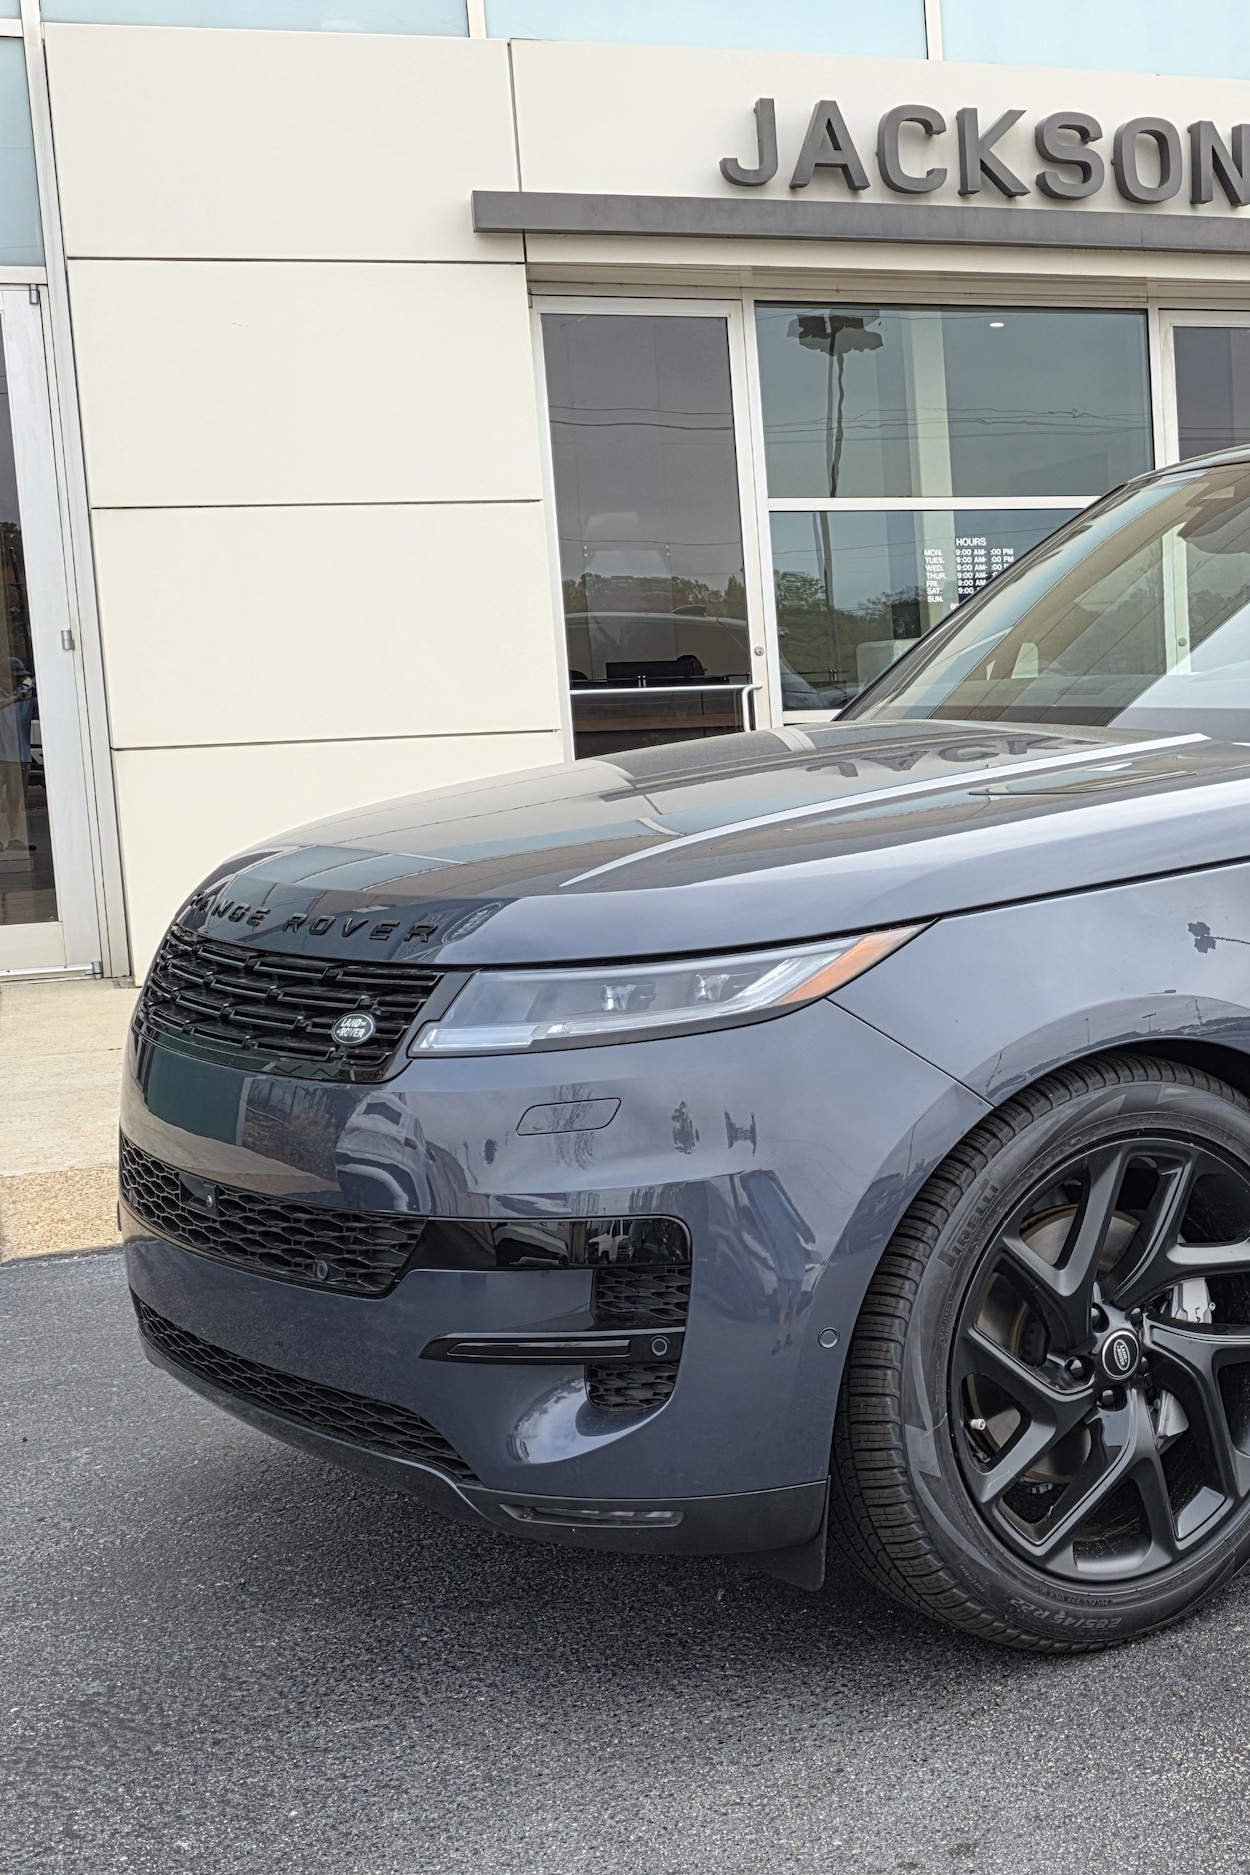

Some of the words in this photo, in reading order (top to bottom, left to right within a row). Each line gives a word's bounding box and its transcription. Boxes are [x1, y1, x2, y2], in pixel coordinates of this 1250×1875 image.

[956, 538, 986, 546] HOURS
[926, 572, 947, 580] THUR.
[927, 587, 943, 595] SAT.
[927, 595, 944, 603] SUN.
[192, 892, 271, 927] RANGE
[281, 912, 439, 943] ROVER
[340, 1018, 363, 1028] LAND
[338, 1027, 365, 1038] ROVER
[937, 1178, 1000, 1269] PIRELLI
[1010, 1597, 1051, 1620] R22
[1050, 1614, 1123, 1629] 285/45
